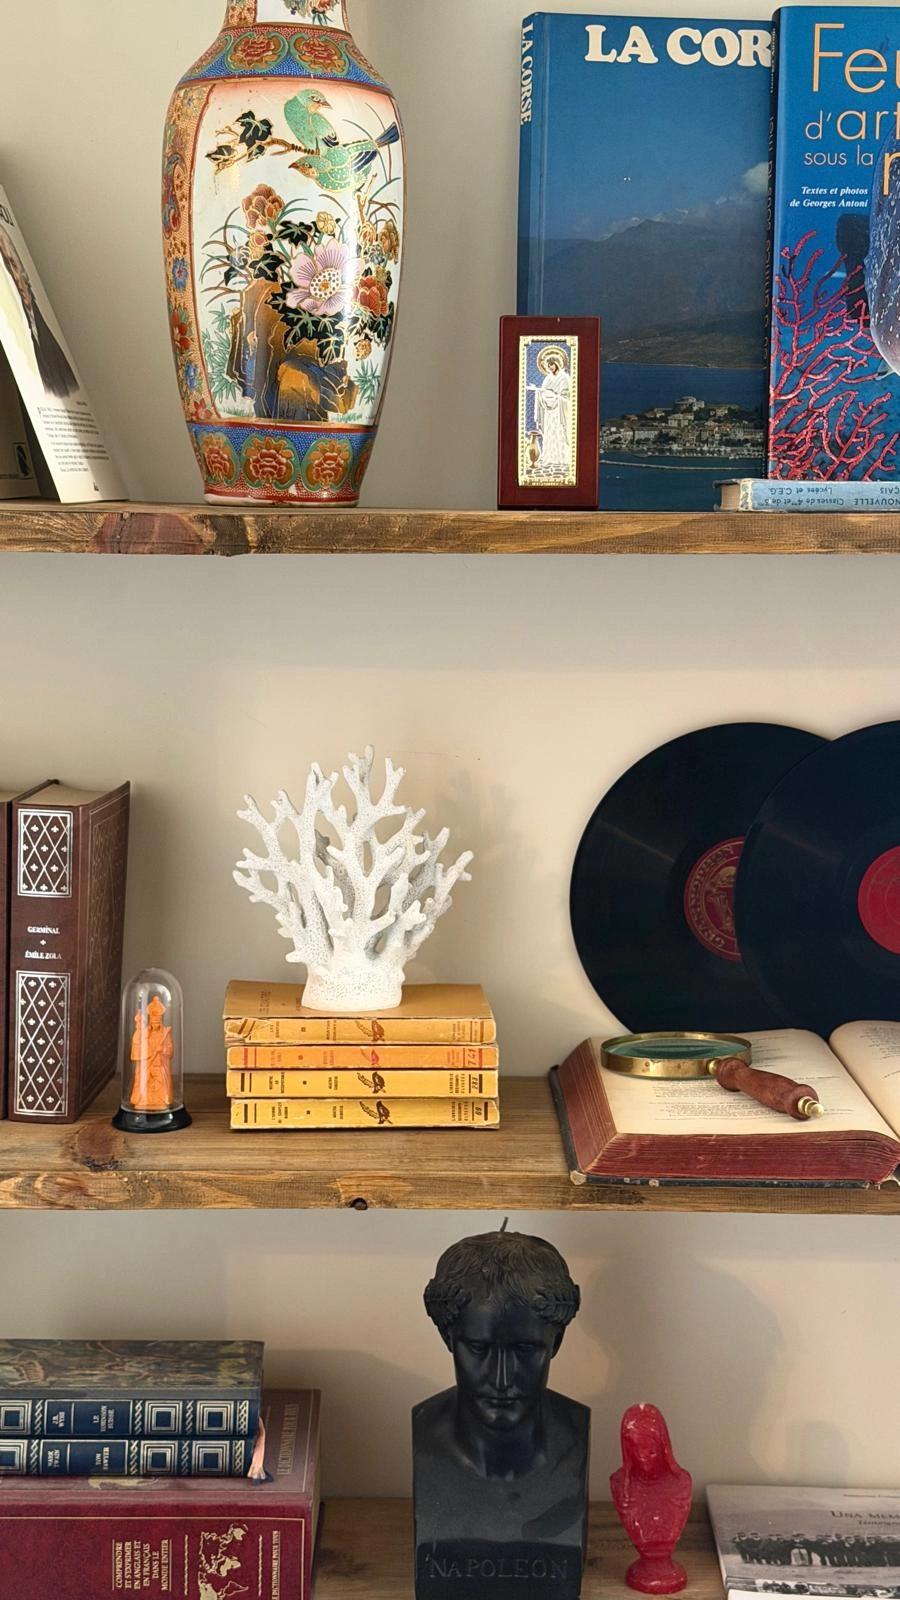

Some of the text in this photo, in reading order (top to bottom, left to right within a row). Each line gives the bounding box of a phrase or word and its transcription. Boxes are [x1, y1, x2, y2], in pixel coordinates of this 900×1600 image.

[585, 25, 772, 68] LA COR
[520, 22, 534, 125] LA CORSE
[803, 144, 874, 166] sous la
[801, 186, 869, 197] Textes et photos
[789, 198, 869, 209] de Georges Antoni
[768, 487, 793, 495] C.E.G.
[807, 486, 832, 495] Lycées
[806, 498, 815, 506] de
[816, 498, 844, 506] Classes
[27, 925, 60, 935] GERMINAL
[45, 952, 62, 960] ZOLA
[134, 1540, 141, 1549] ET
[152, 1551, 159, 1560] LE
[115, 1541, 123, 1589] COMPRENDRE
[124, 1541, 132, 1589] ET S'EXPRIMER
[142, 1543, 151, 1587] EN FRANÇAIS
[429, 1557, 568, 1579] NAPOLEON
[133, 1579, 141, 1590] EN
